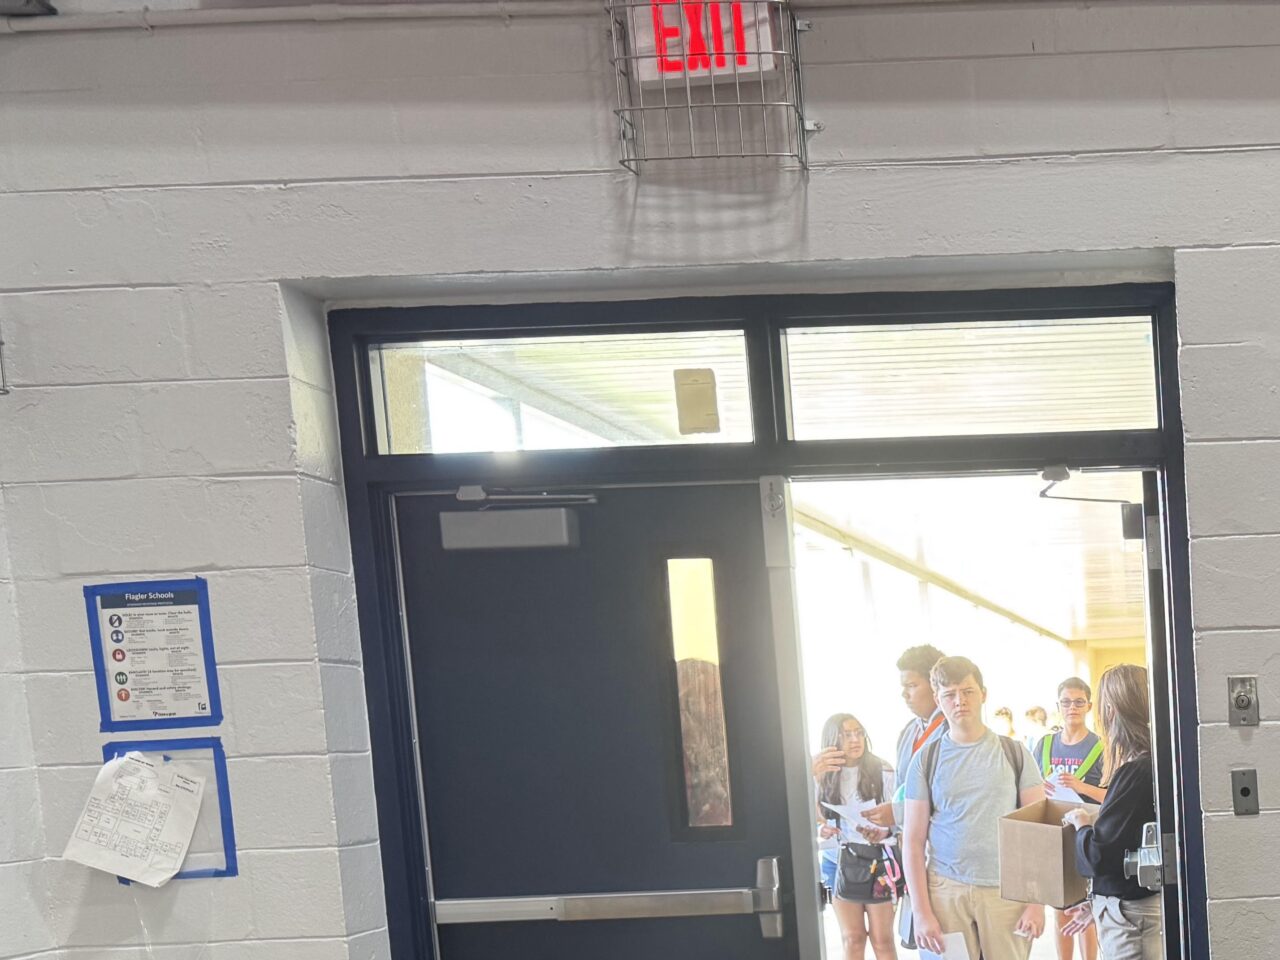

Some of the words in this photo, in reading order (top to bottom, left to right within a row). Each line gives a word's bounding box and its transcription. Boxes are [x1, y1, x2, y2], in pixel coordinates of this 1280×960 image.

[651, 0, 748, 73] EXIT
[125, 592, 147, 601] Flagler
[148, 591, 174, 600] Schools
